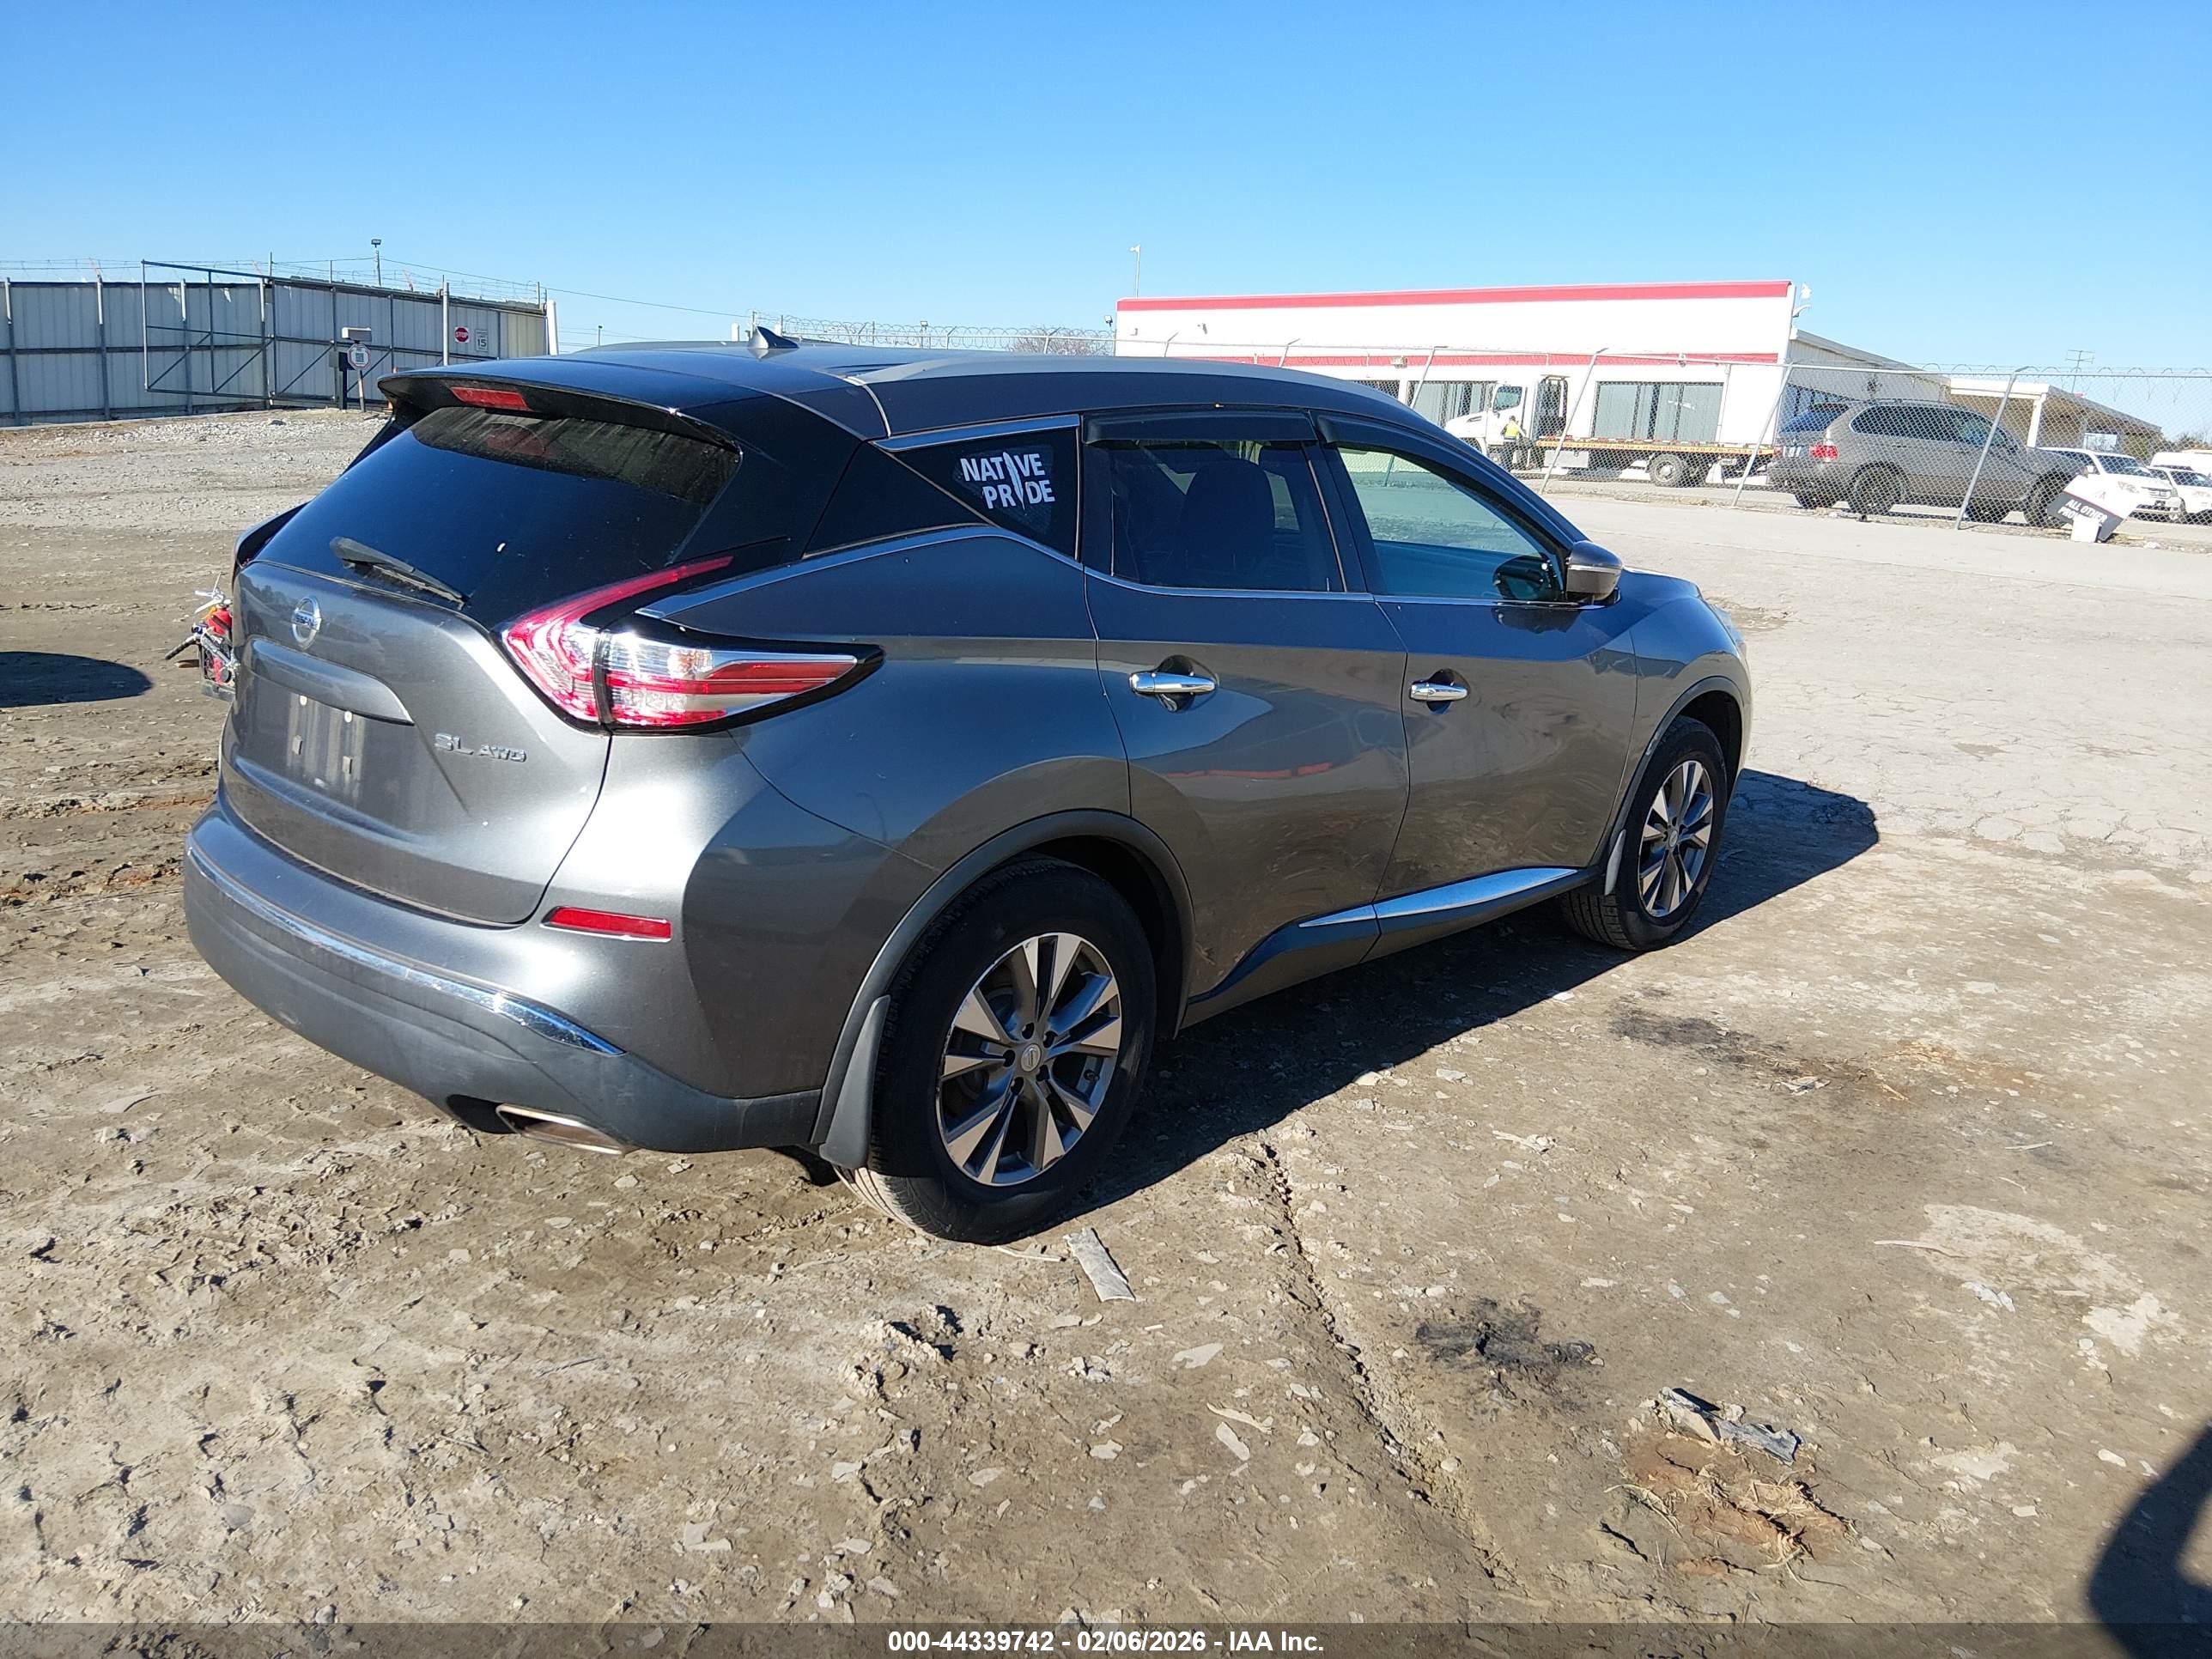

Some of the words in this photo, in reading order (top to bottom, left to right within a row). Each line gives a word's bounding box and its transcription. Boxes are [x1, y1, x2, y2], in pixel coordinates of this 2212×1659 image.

[477, 338, 487, 347] 15
[960, 452, 1046, 481] NATIVE
[982, 480, 1055, 510] PRIDE
[2065, 499, 2081, 512] ALL
[2080, 506, 2108, 523] OTHER
[434, 732, 475, 756] SL
